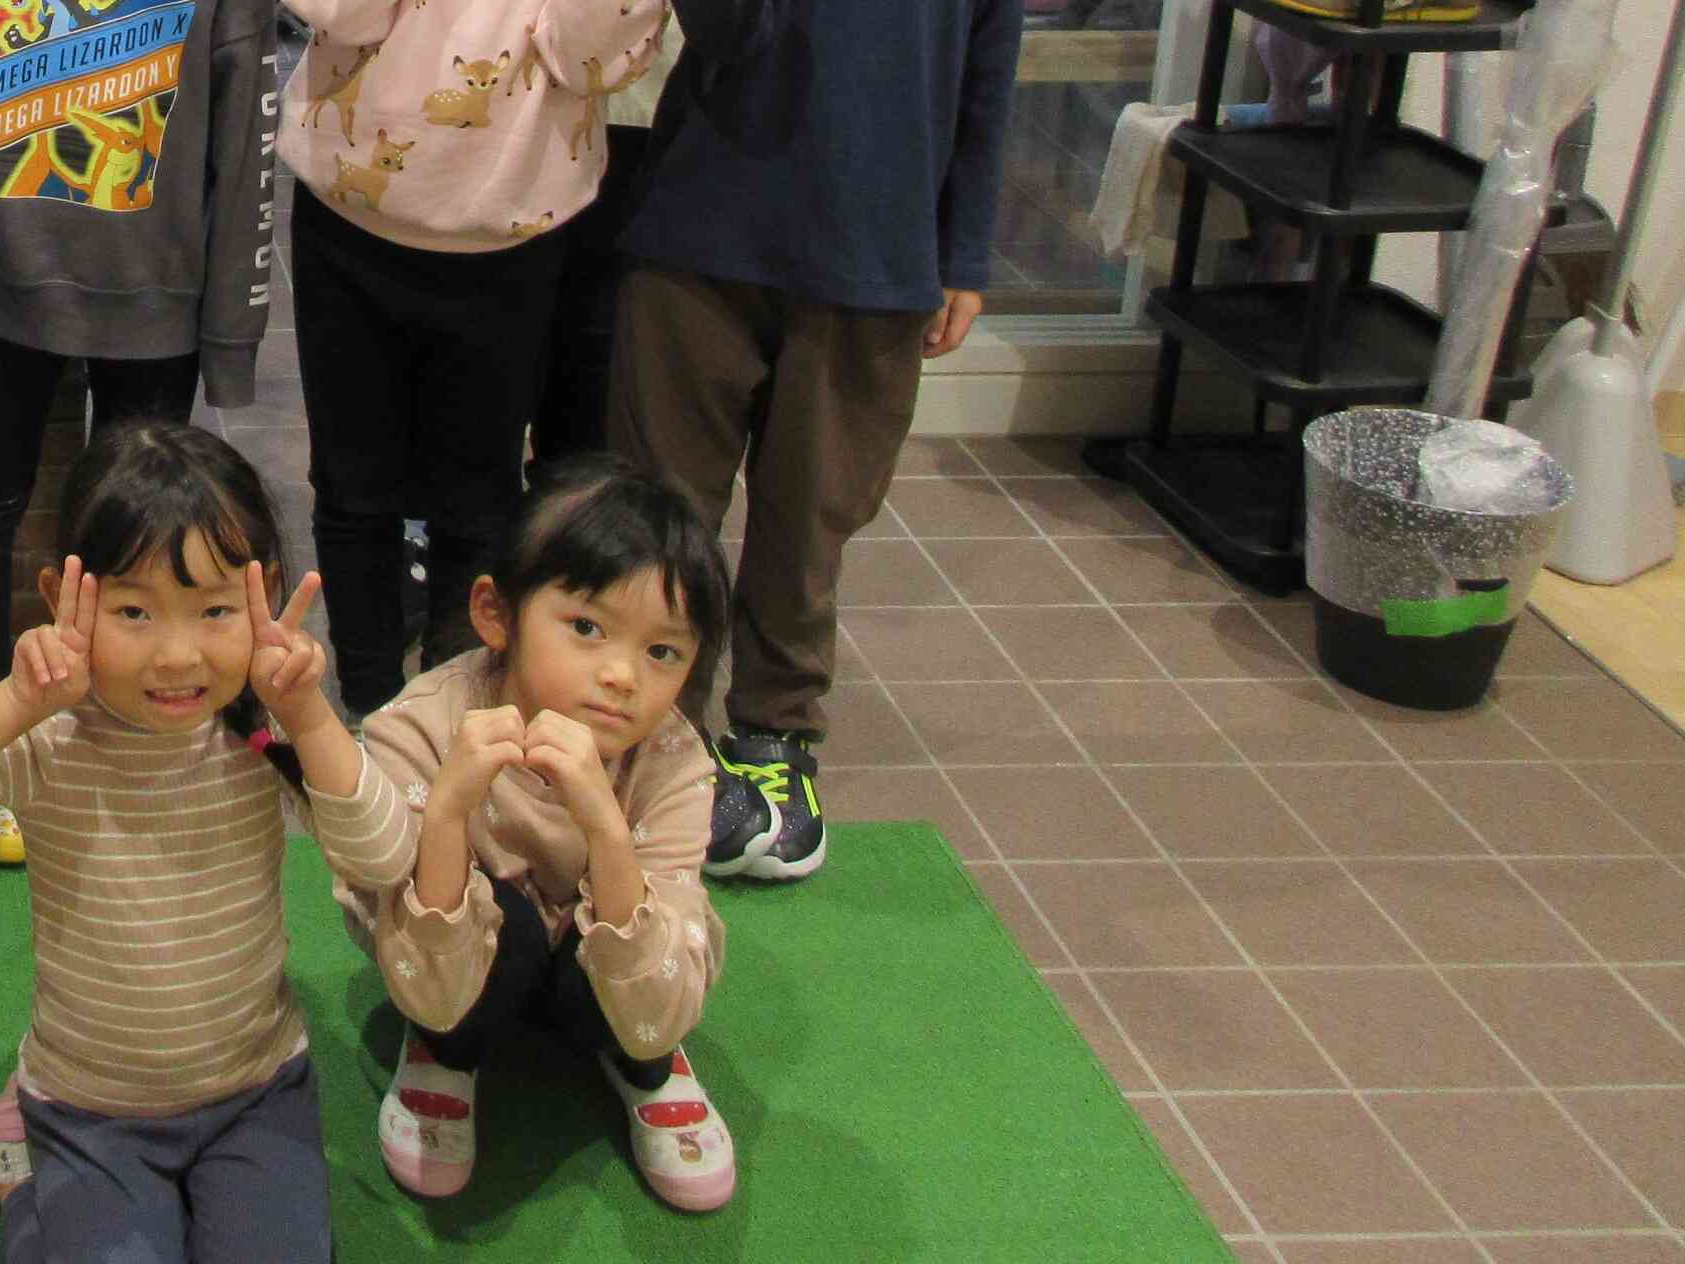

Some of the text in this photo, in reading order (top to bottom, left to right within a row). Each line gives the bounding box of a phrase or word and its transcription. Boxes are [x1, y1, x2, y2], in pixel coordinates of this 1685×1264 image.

[58, 16, 164, 73] LIZARDON
[170, 11, 189, 36] X
[53, 60, 161, 117] LIZARDON
[165, 52, 179, 80] Y
